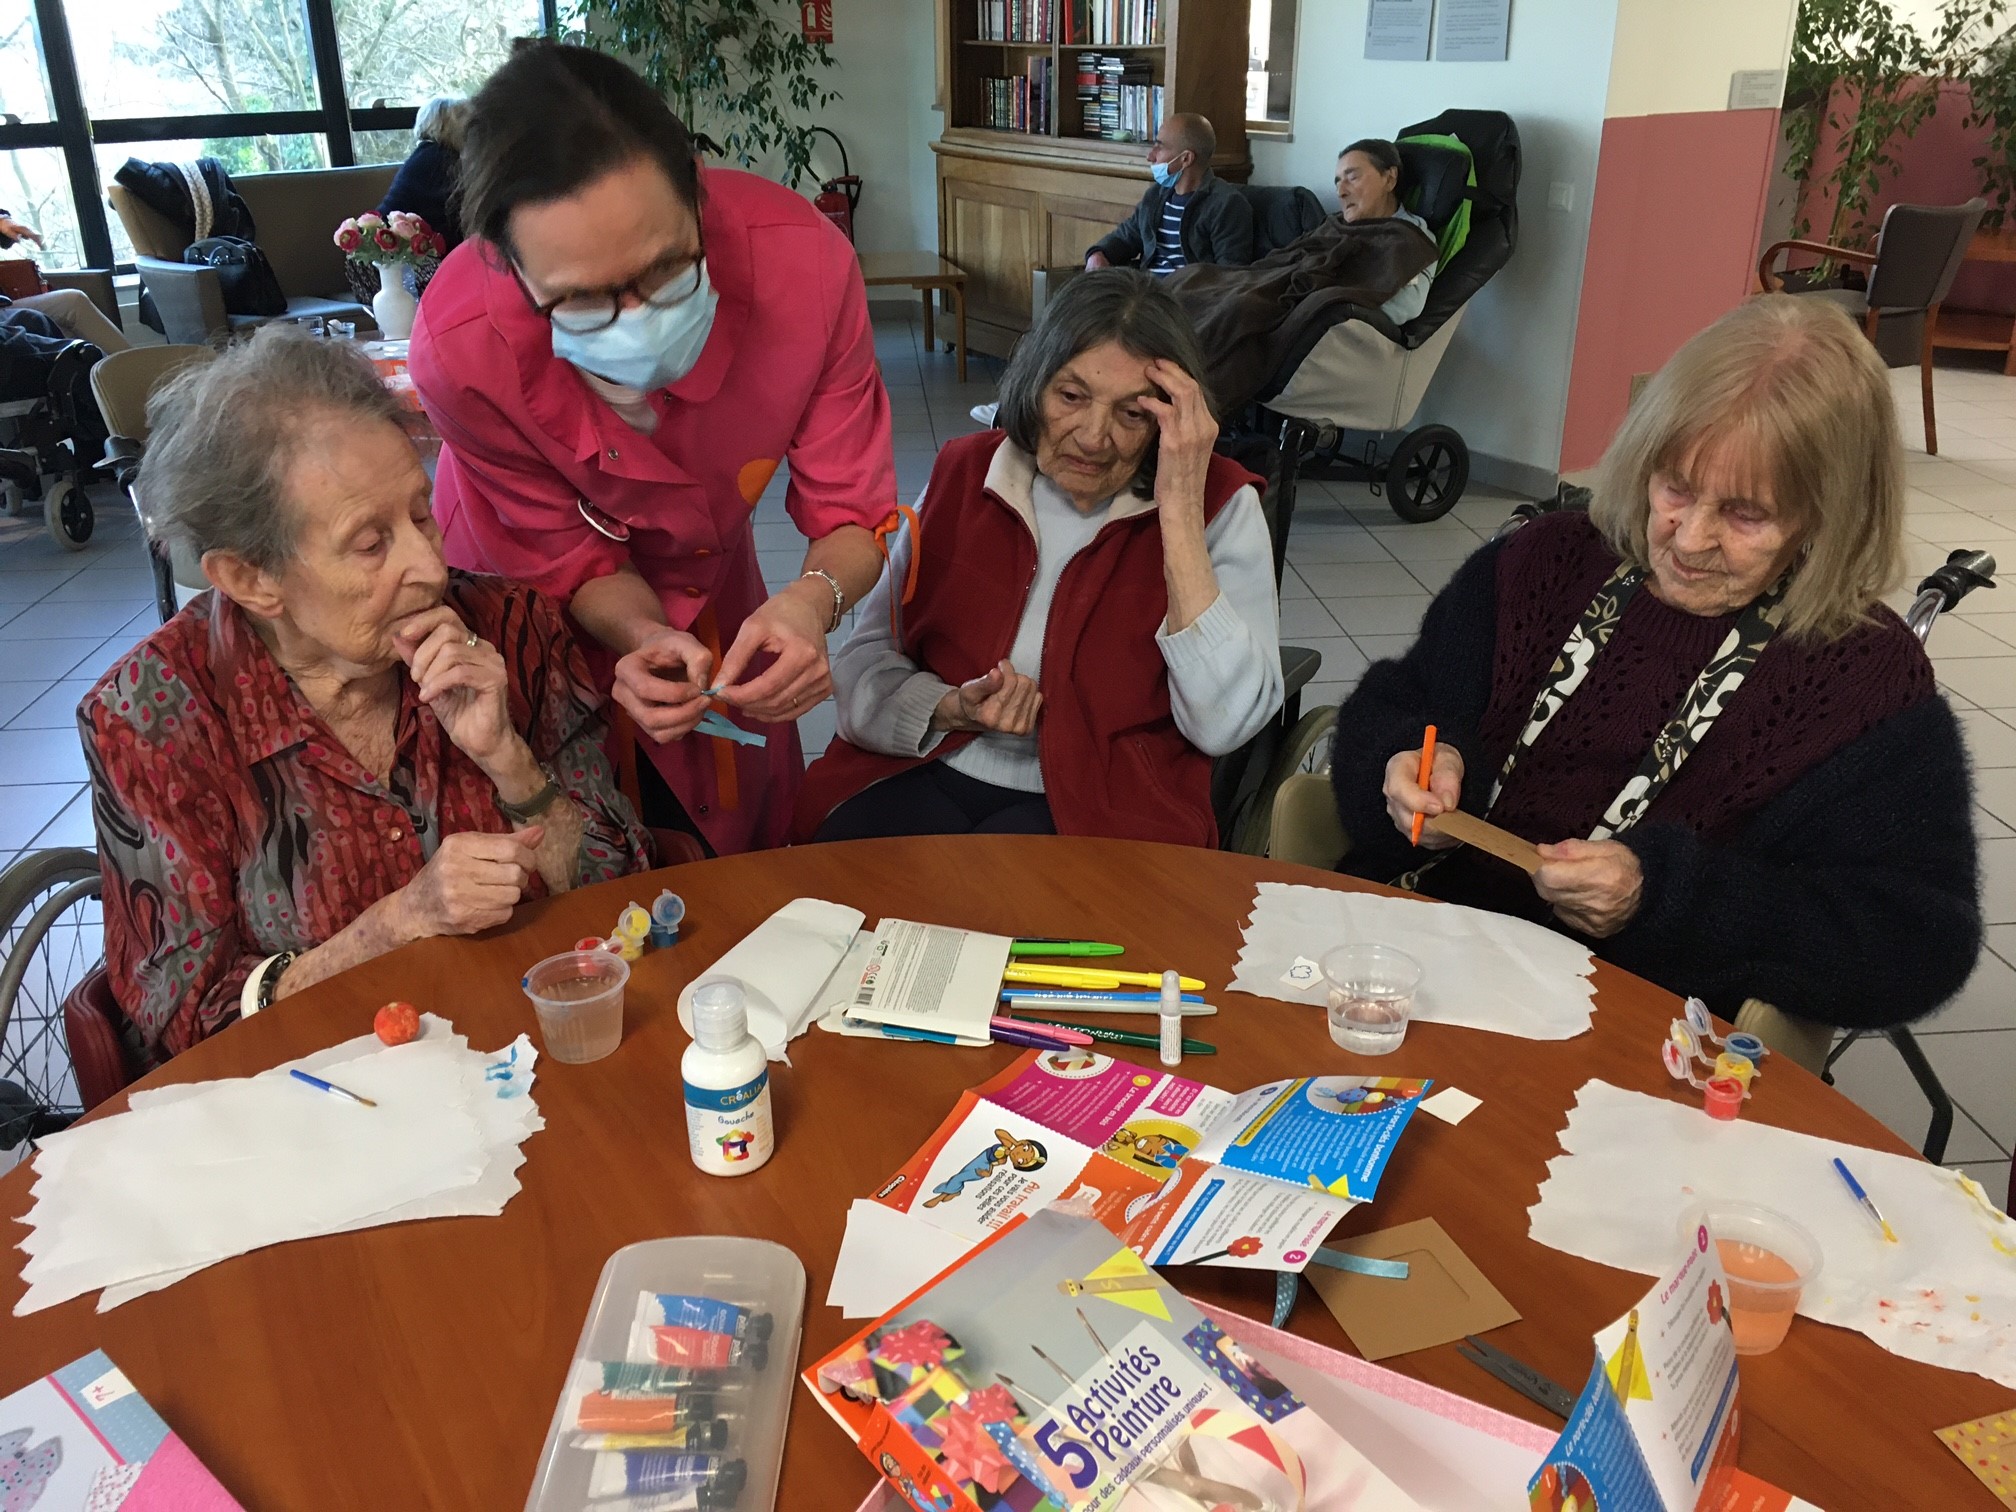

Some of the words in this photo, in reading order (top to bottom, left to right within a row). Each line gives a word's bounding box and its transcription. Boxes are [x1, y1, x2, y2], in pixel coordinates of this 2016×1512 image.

[1113, 1093, 1134, 1111] bracelet
[717, 1111, 754, 1125] Gouache
[1098, 1115, 1112, 1126] bois
[1378, 1115, 1399, 1144] porte-clés
[1360, 1144, 1385, 1181] bonhomme
[975, 1168, 1008, 1199] réalisations
[1003, 1173, 1017, 1186] pour
[1017, 1177, 1027, 1185] Je
[1023, 1180, 1040, 1195] Au
[992, 1185, 1004, 1195] ces
[1006, 1184, 1020, 1196] vais
[976, 1194, 996, 1211] belles
[993, 1195, 1009, 1208] vous
[996, 1193, 1027, 1220] travail
[985, 1218, 1002, 1230] !!!
[1660, 1290, 1670, 1304] Le
[1066, 1345, 1161, 1435] Activités
[1090, 1375, 1181, 1462] Peinture
[1564, 1440, 1574, 1457] Le
[1571, 1401, 1595, 1445] porte-clés
[1099, 1483, 1116, 1500] des
[1113, 1455, 1143, 1486] cadeaux
[1140, 1411, 1186, 1460] personnalisés
[1184, 1387, 1209, 1415] uniques
[1033, 1418, 1098, 1490] 5
